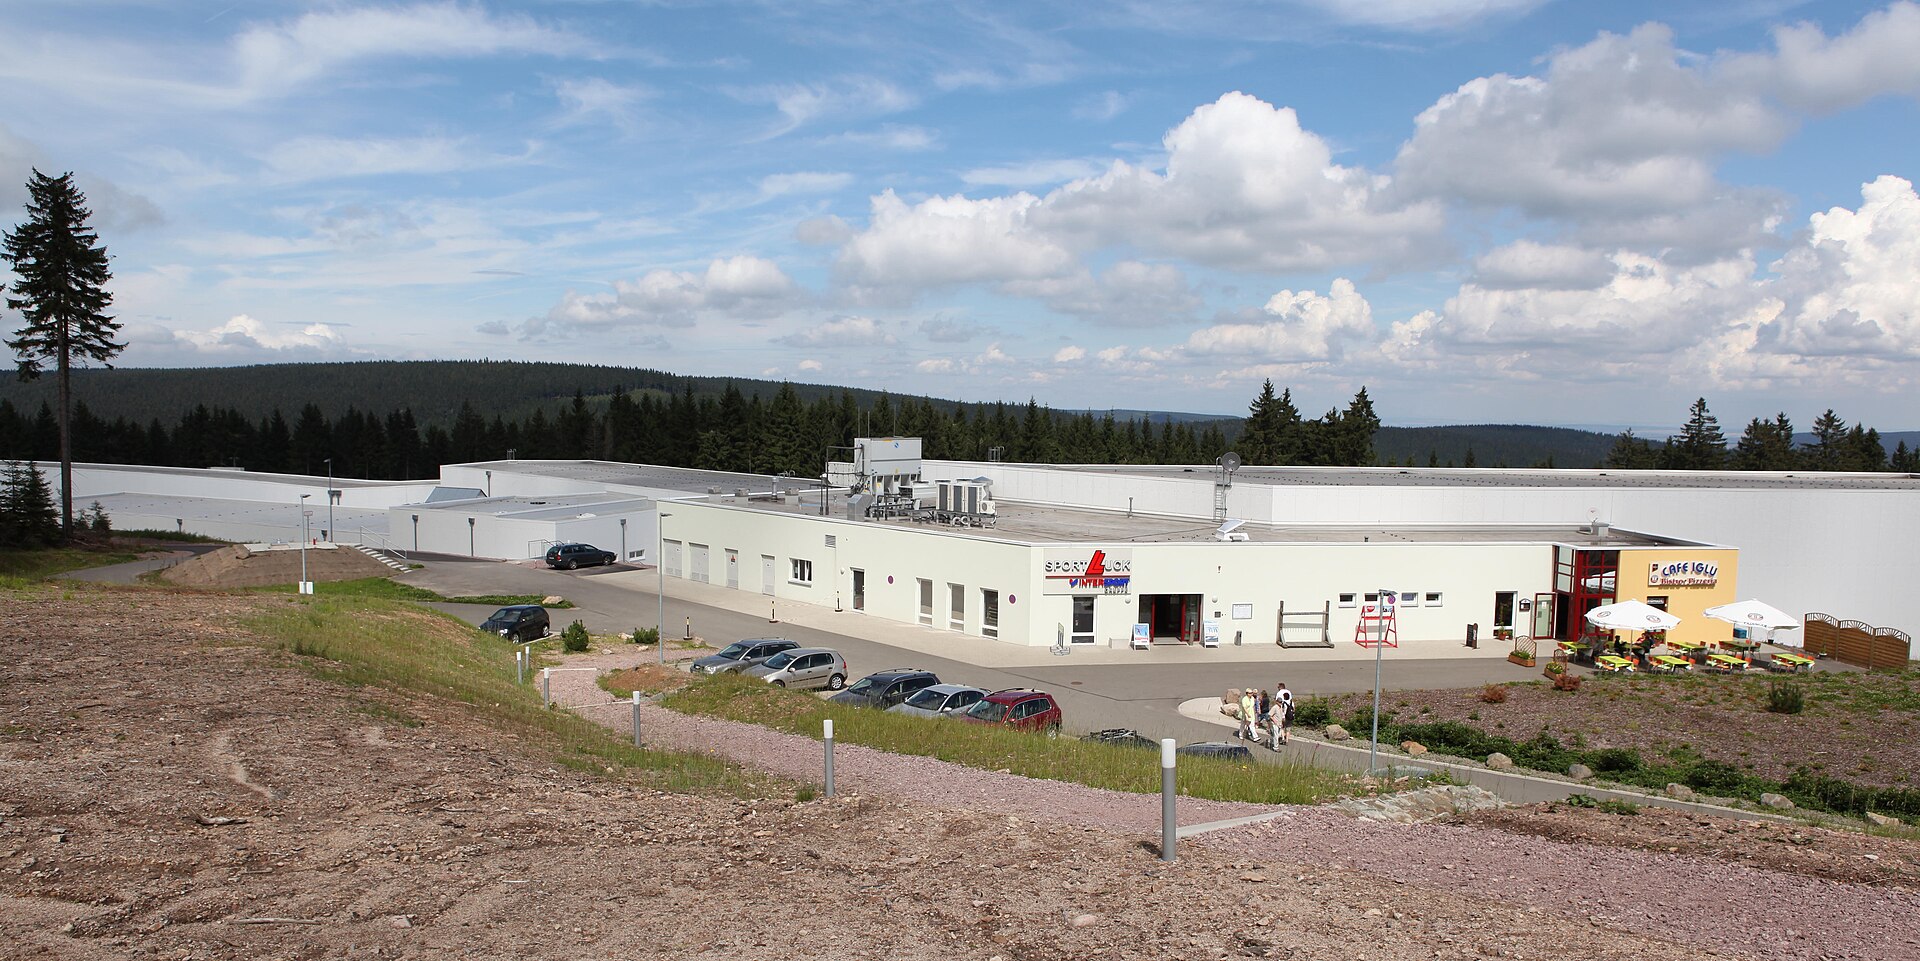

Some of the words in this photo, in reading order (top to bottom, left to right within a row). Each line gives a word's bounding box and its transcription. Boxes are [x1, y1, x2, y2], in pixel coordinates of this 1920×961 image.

[1045, 559, 1087, 572] SPORT
[1662, 562, 1688, 576] CAFE
[1692, 562, 1718, 576] IGLU
